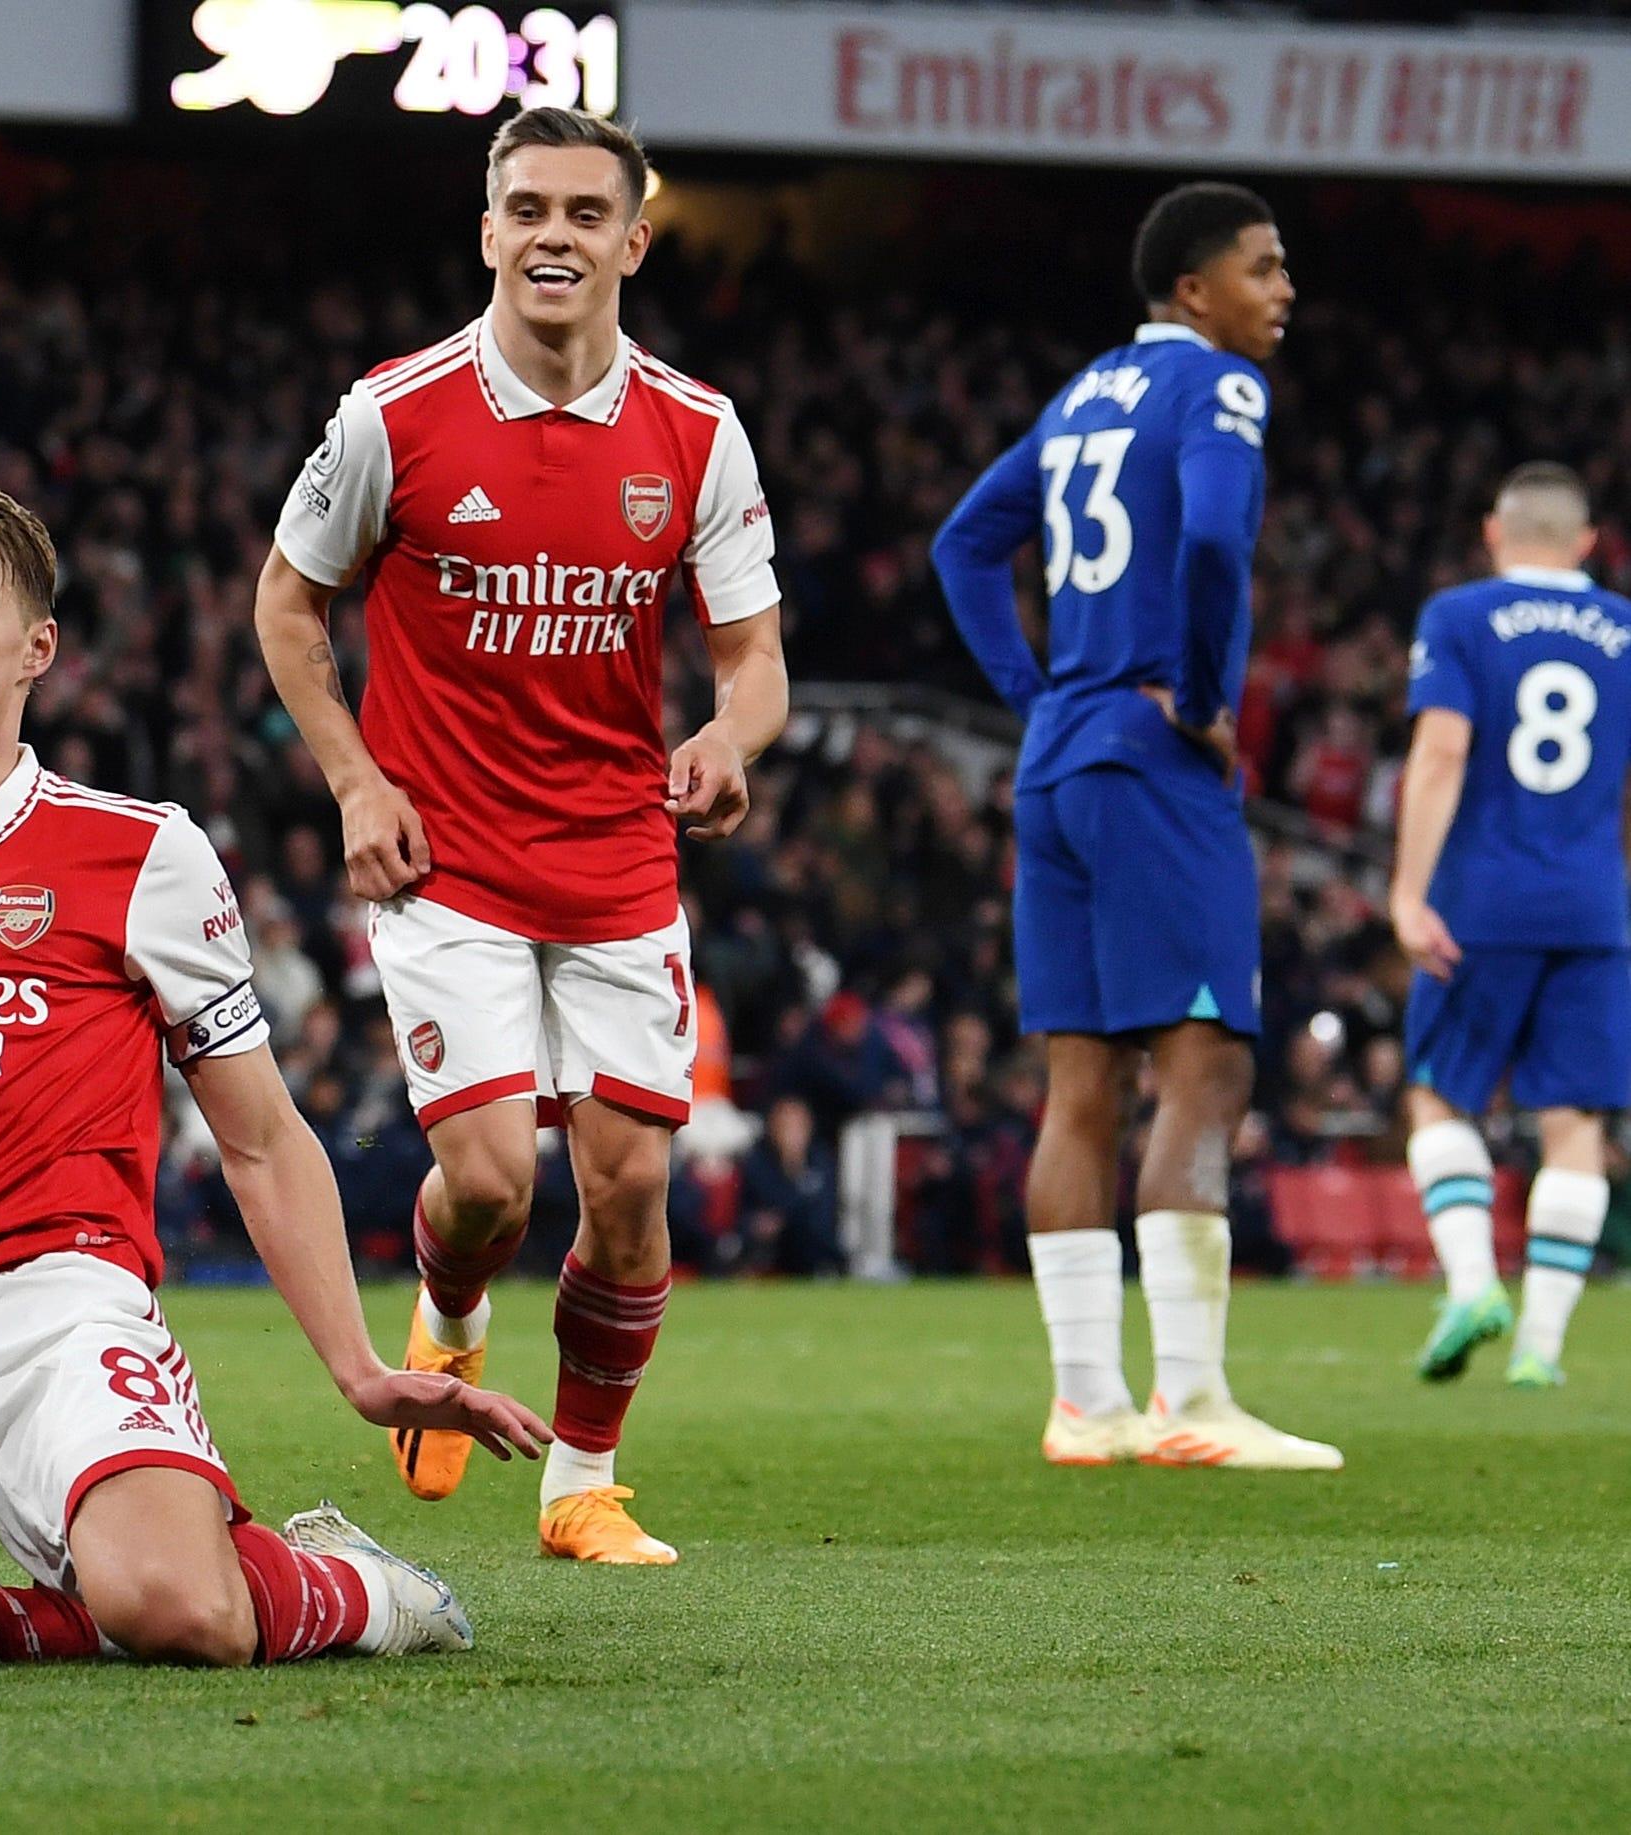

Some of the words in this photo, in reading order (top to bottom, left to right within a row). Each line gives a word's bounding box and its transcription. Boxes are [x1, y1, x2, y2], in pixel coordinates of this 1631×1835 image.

[394, 3, 617, 116] 20:31
[836, 27, 1233, 143] Emirates
[448, 507, 501, 524] adidas
[1039, 427, 1137, 597] 33
[433, 552, 666, 606] Emirates
[466, 610, 523, 655] FLY
[530, 613, 635, 656] BETTER
[1506, 659, 1599, 794] 8
[100, 1347, 170, 1405] 8
[119, 1420, 175, 1436] adidas
